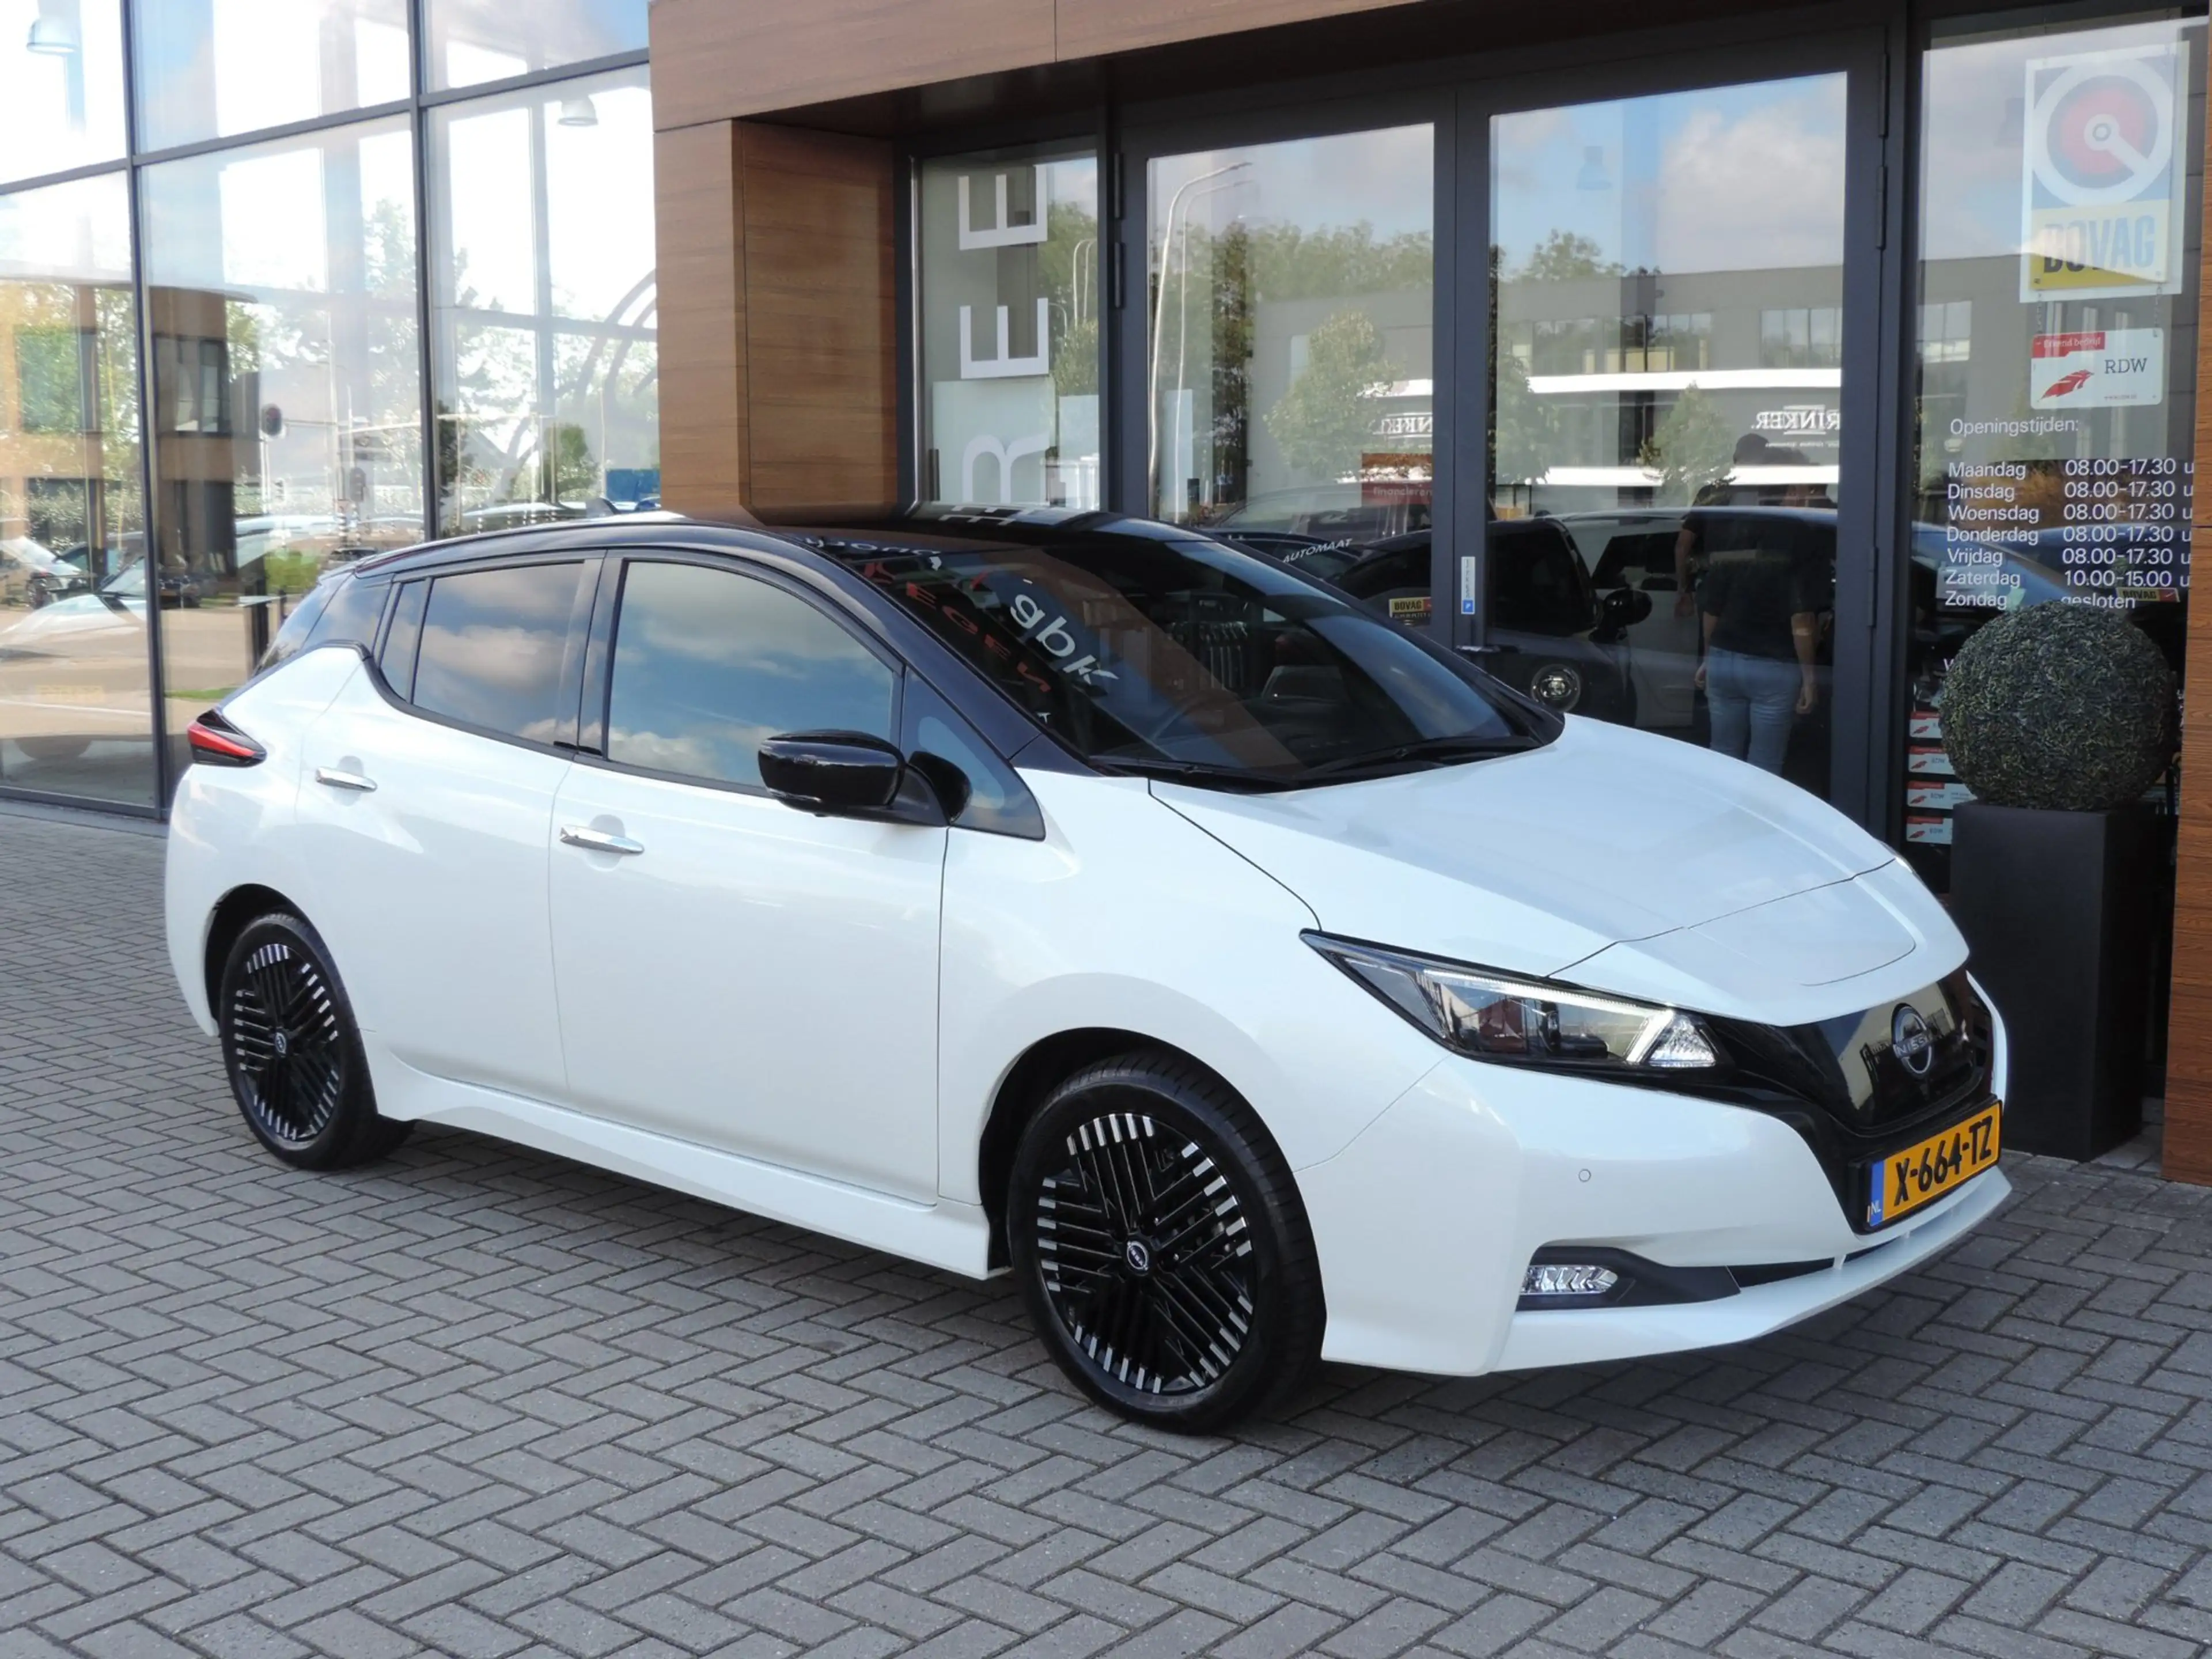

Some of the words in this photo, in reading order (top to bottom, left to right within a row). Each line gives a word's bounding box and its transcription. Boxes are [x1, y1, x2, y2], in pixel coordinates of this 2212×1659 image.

[2043, 215, 2156, 274] BOVAG
[2104, 358, 2148, 374] RDW
[1950, 418, 2079, 436] Openingstijden:
[1949, 461, 2026, 480] Maandag
[2065, 458, 2176, 476] 08.00-17.30
[1948, 483, 2015, 502] Dinsdag
[2064, 480, 2175, 498] 08.00-17.30
[1948, 505, 2039, 524] Woensdag
[2063, 503, 2175, 520] 08.00-17.30
[1946, 526, 2039, 546] Donderdag
[2063, 525, 2173, 542] 08.00-17.30
[1282, 538, 1353, 563] AUTOMAAT
[1947, 548, 2003, 567] Vrijdag
[2062, 548, 2173, 565] 08.00-17.30
[1945, 569, 2020, 588] Zaterdag
[2065, 570, 2172, 587] 10.00-15.00
[1393, 600, 1422, 611] BOVAG
[1945, 590, 2008, 610] Zondag
[1896, 1033, 1931, 1056] NISS
[1893, 1115, 1992, 1206] X-664-TZ
[1870, 1200, 1881, 1215] NL
